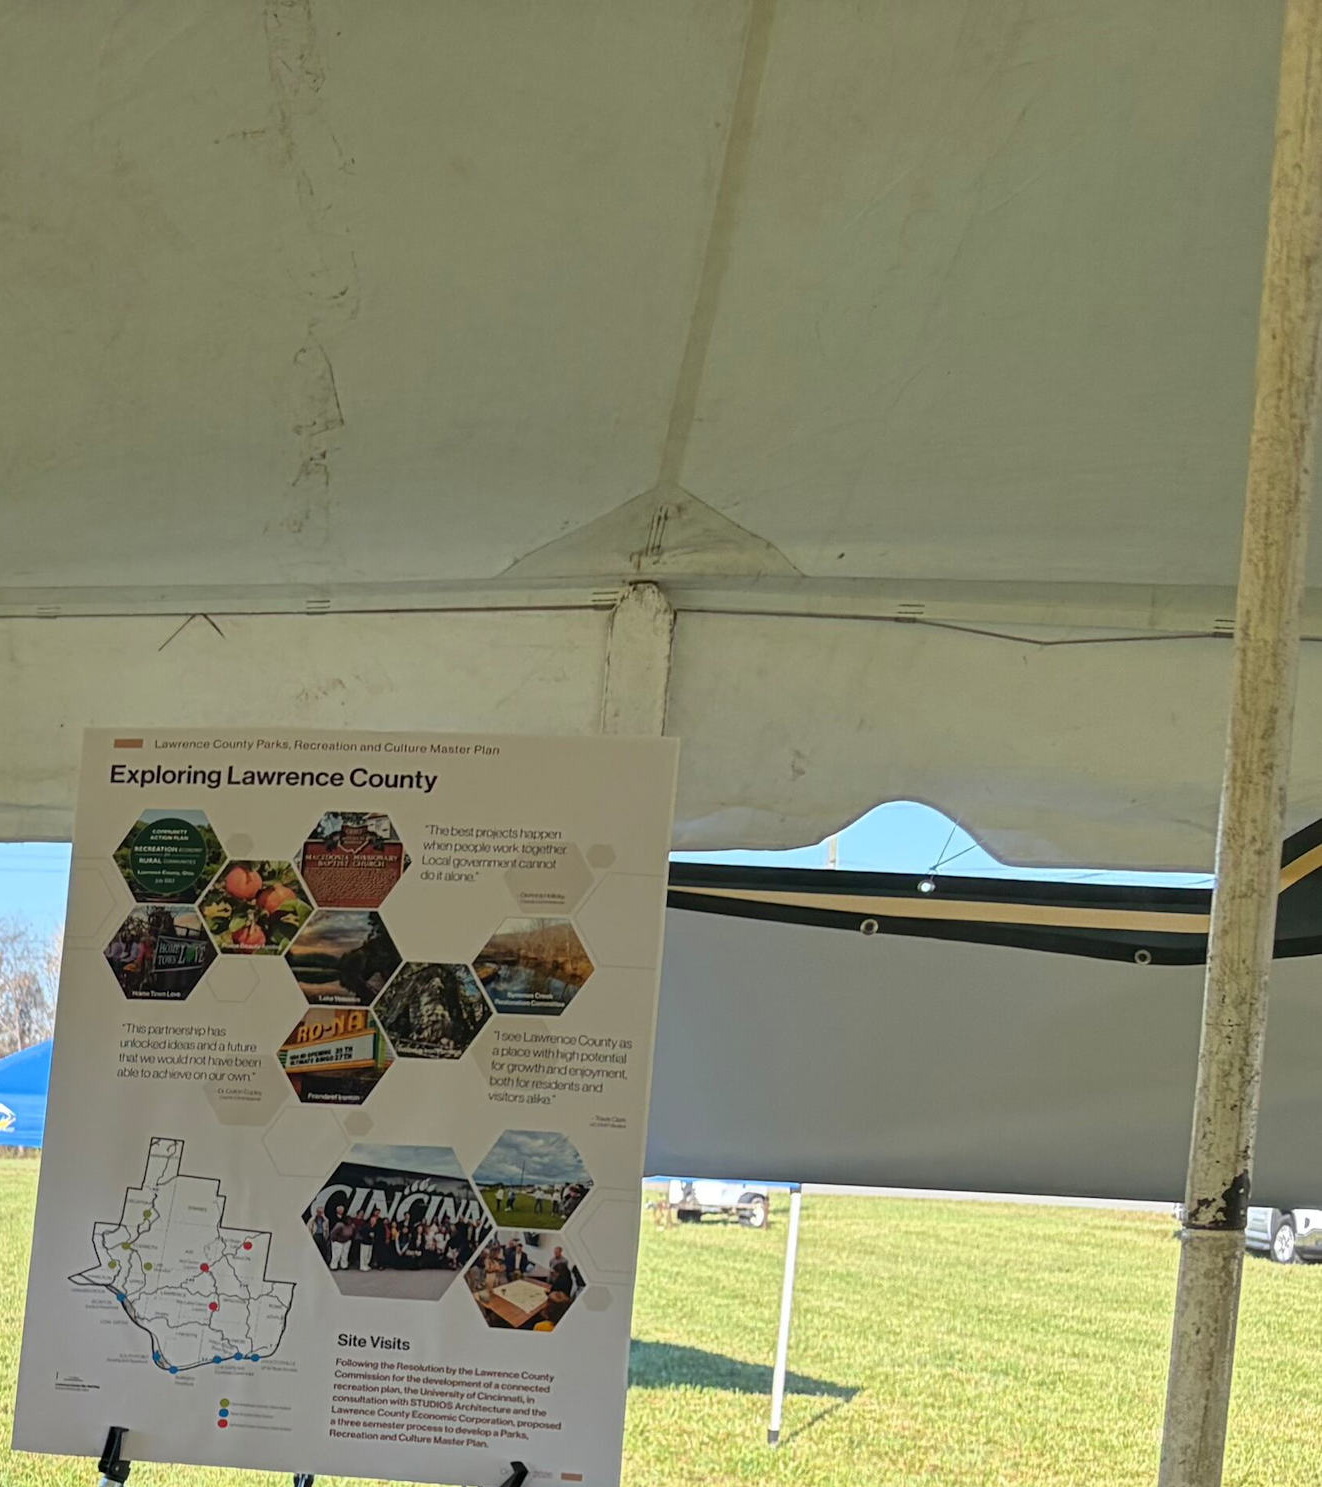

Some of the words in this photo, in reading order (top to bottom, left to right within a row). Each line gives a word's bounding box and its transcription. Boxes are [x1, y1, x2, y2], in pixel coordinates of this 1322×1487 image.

[154, 739, 209, 749] Lawrence
[213, 739, 253, 750] County
[257, 740, 292, 750] Parks,
[294, 740, 357, 751] Recreation
[360, 743, 381, 752] and
[384, 743, 427, 753] Culture
[430, 744, 470, 754] Master
[474, 745, 500, 755] Plan
[110, 765, 221, 789] Exploring
[227, 765, 344, 787] Lawrence
[350, 768, 438, 793] County
[425, 825, 449, 836] "The
[451, 826, 474, 838] best
[475, 828, 518, 840] projects
[520, 828, 562, 841] happen
[422, 855, 451, 866] Local
[453, 857, 517, 869] government
[518, 859, 556, 869] cannot
[122, 1023, 146, 1034] "This
[148, 1025, 206, 1037] partnership
[207, 1026, 226, 1037] has
[120, 1039, 166, 1050] unlocked
[168, 1040, 195, 1050] ideas
[197, 1042, 217, 1051] and
[227, 1043, 257, 1052] future
[501, 1032, 522, 1042] see
[524, 1032, 576, 1045] Lawrence
[578, 1035, 617, 1049] County
[619, 1039, 632, 1049] as
[337, 1334, 367, 1347] Site
[370, 1336, 410, 1351] Visits
[335, 1358, 379, 1370] Following
[381, 1361, 395, 1370] the
[397, 1362, 445, 1373] Resolution
[446, 1366, 456, 1375] by
[459, 1367, 473, 1375] the
[475, 1368, 519, 1379] Lawrence
[521, 1372, 554, 1382] County
[335, 1370, 390, 1381] Commission
[392, 1374, 405, 1382] for
[407, 1375, 421, 1383] the
[422, 1377, 482, 1388] development
[501, 1384, 550, 1393] connected
[333, 1383, 379, 1392] recreation
[381, 1385, 401, 1394] plan,
[404, 1387, 418, 1395] the
[420, 1388, 465, 1400] University
[477, 1392, 525, 1404] Cincinnati,
[527, 1396, 535, 1404] in
[332, 1395, 388, 1405] consultation
[390, 1397, 409, 1406] with
[410, 1399, 453, 1410] STUDIOS
[455, 1402, 511, 1414] Architecture
[513, 1408, 530, 1416] and
[532, 1409, 547, 1417] the
[331, 1405, 375, 1416] Lawrence
[377, 1408, 410, 1419] County
[412, 1410, 457, 1421] Economic
[459, 1414, 515, 1426] Corporation,
[517, 1420, 562, 1430] proposed
[329, 1429, 378, 1440] Recreation
[380, 1431, 397, 1441] and
[398, 1433, 432, 1443] Culture
[433, 1436, 465, 1446] Master
[466, 1438, 489, 1448] Plan.
[337, 1418, 361, 1427] three
[363, 1420, 405, 1430] semester
[406, 1423, 443, 1433] process
[445, 1425, 453, 1433] to
[455, 1426, 491, 1438] develop
[500, 1430, 529, 1440] Parks,
